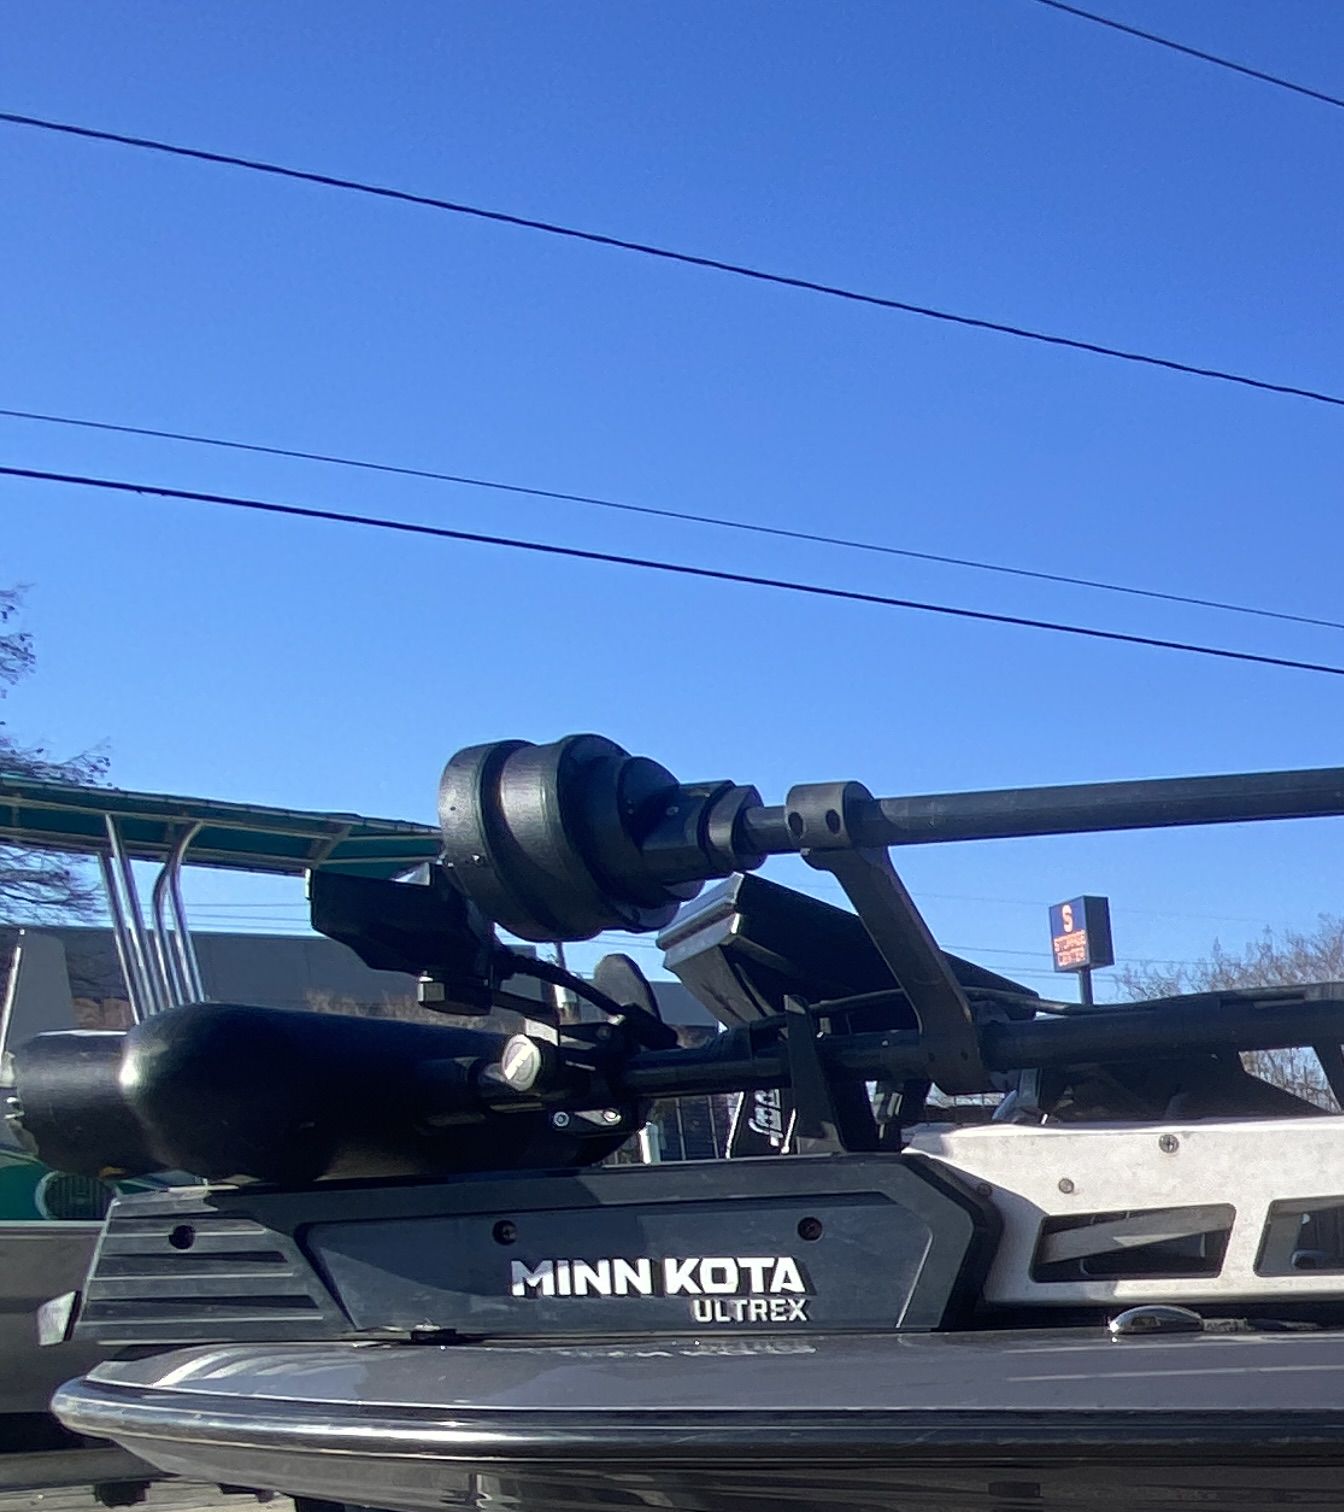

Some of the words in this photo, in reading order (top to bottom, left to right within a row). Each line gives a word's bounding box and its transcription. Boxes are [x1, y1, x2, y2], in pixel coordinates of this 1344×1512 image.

[511, 1258, 651, 1296] MINN
[663, 1256, 806, 1295] KOTA
[693, 1299, 808, 1323] ULTREX
